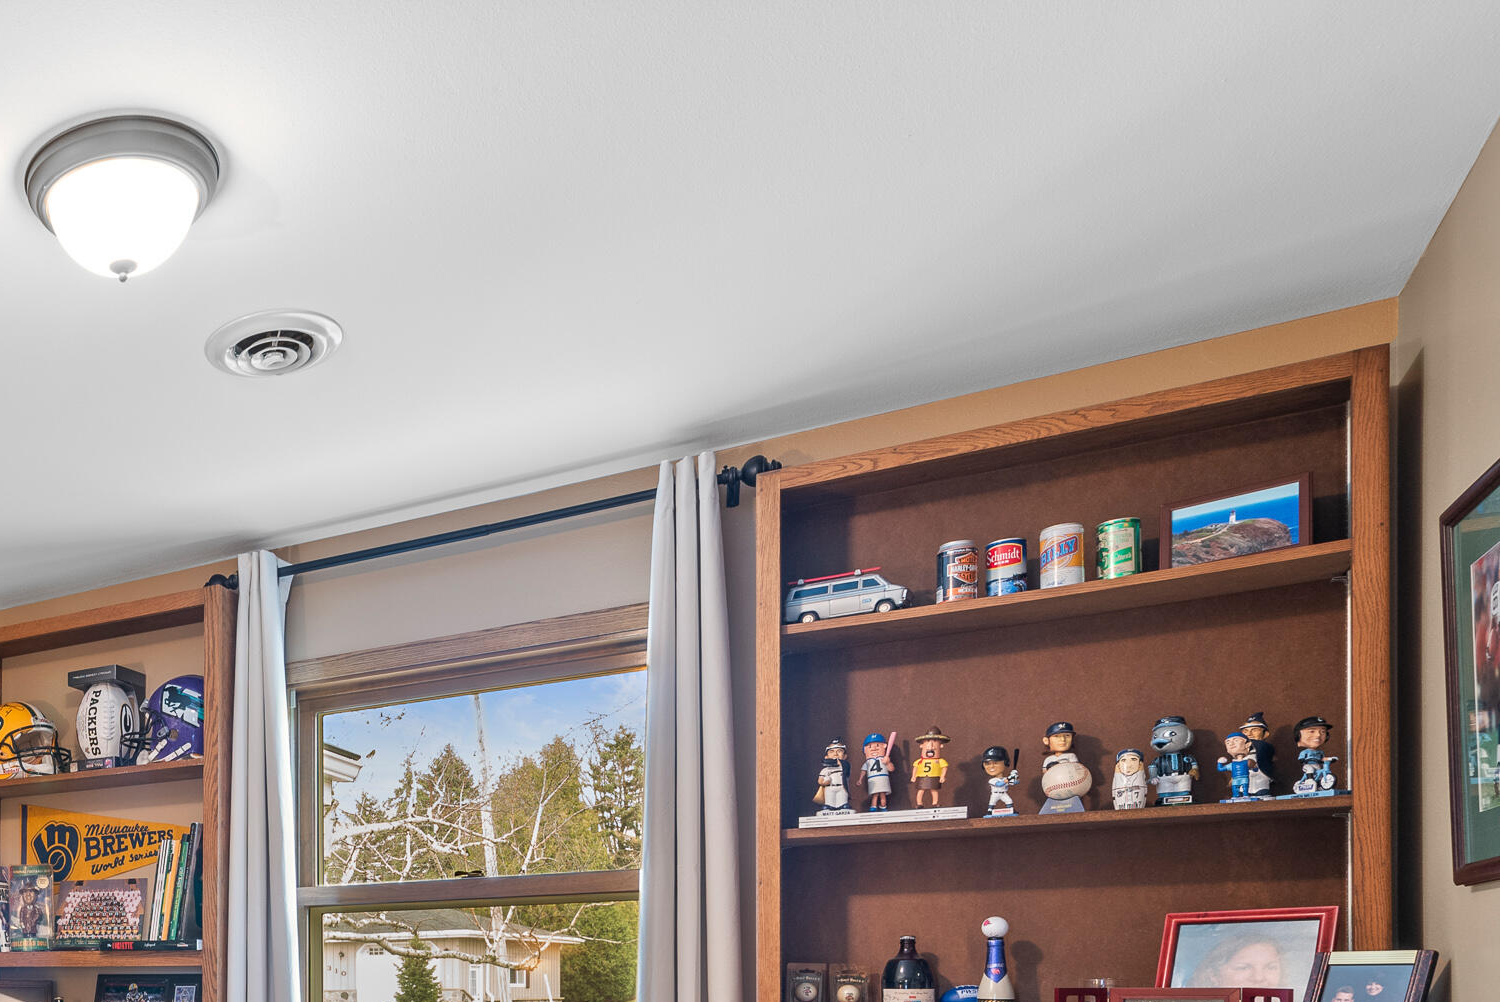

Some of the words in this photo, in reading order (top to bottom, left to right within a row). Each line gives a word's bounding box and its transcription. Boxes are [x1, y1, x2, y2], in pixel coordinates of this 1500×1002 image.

[986, 547, 1021, 566] Schmidt
[1039, 538, 1076, 567] BILLY
[87, 689, 102, 756] PACKERS
[870, 759, 882, 773] 4
[924, 762, 932, 773] 5
[84, 823, 149, 836] Milwaukee
[83, 829, 173, 862] BREWERS
[91, 855, 124, 875] World
